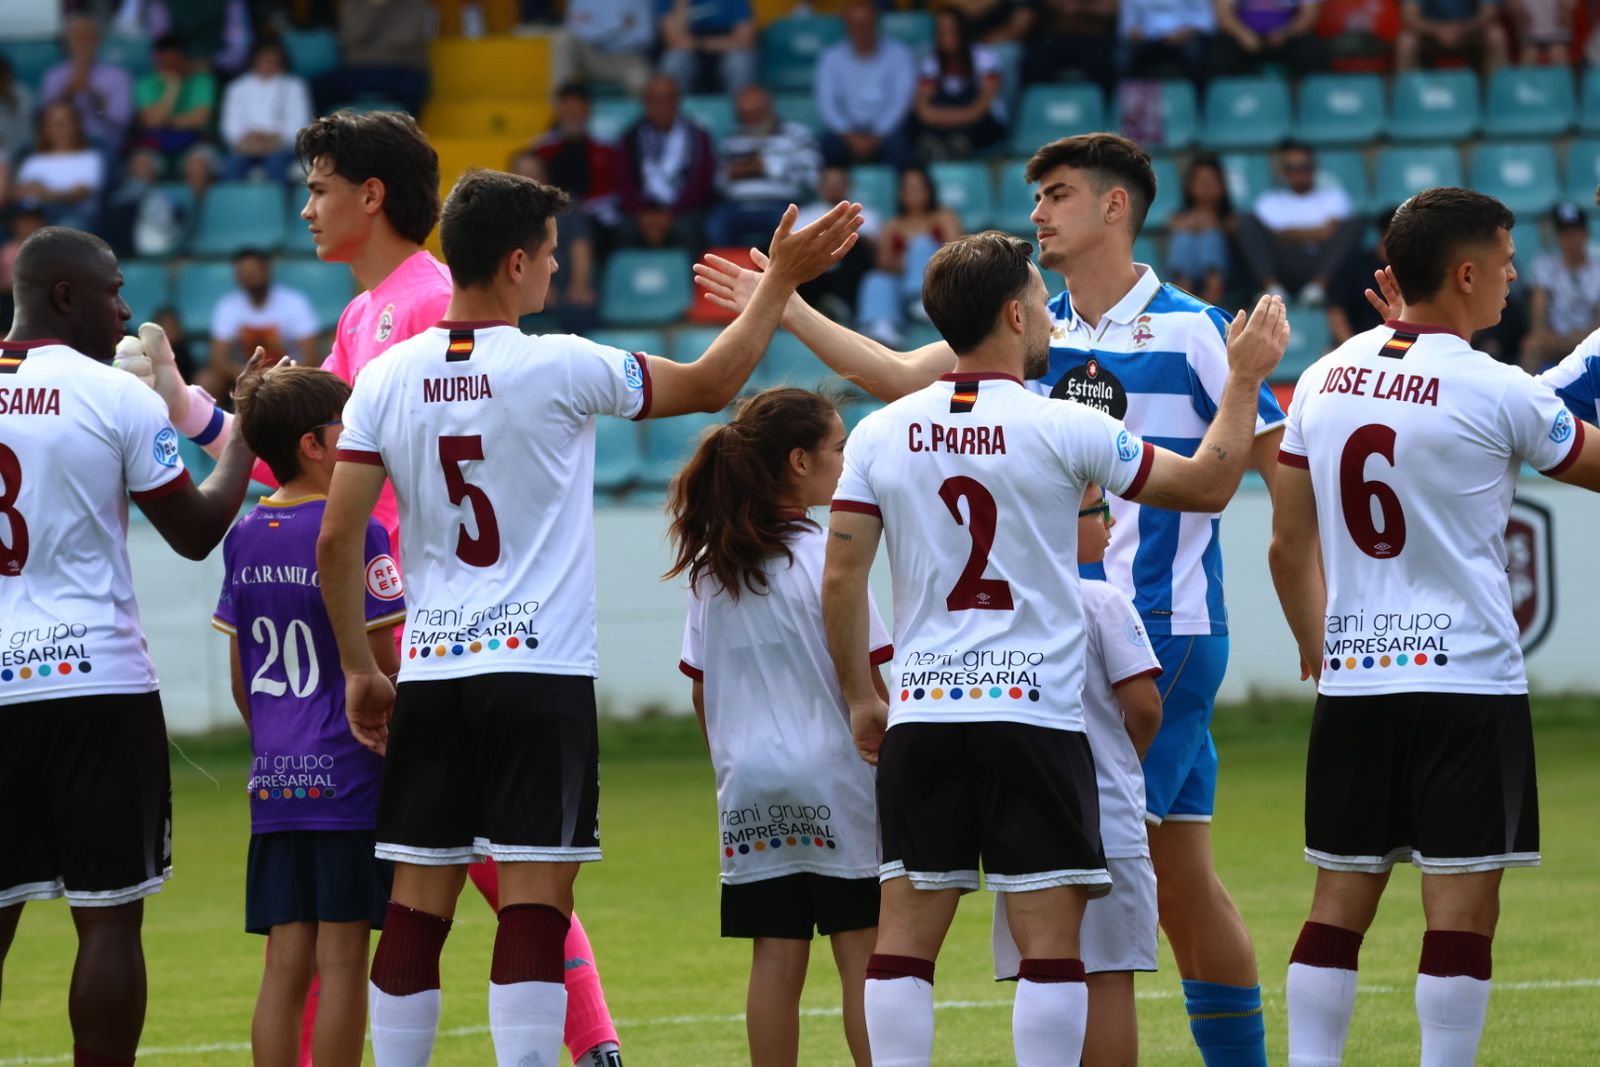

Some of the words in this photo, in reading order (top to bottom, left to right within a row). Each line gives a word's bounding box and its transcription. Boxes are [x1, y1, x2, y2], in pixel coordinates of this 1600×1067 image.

[423, 374, 492, 402] MURUA
[1066, 377, 1113, 400] Estrella
[1319, 366, 1372, 396] JOSE
[1373, 371, 1440, 406] LARA
[908, 422, 1007, 455] C.PARRA
[438, 434, 501, 567] 5
[1339, 423, 1407, 560] 6
[938, 475, 1015, 612] 2
[414, 605, 464, 627] nani
[466, 601, 539, 627] grupo
[1325, 608, 1364, 634] ani
[1373, 613, 1452, 637] grupo
[9, 623, 87, 650] grupo
[410, 619, 539, 645] EMPRESARIAL
[0, 644, 91, 667] ESARIAL
[250, 616, 320, 698] 20
[962, 650, 1044, 672] grupo
[901, 670, 1042, 688] EMPRESARIAL
[253, 752, 268, 771] ni
[273, 754, 334, 775] grupo
[721, 802, 761, 827] nani
[768, 804, 831, 823] grupo
[723, 823, 835, 845] EMPRESARIAL
